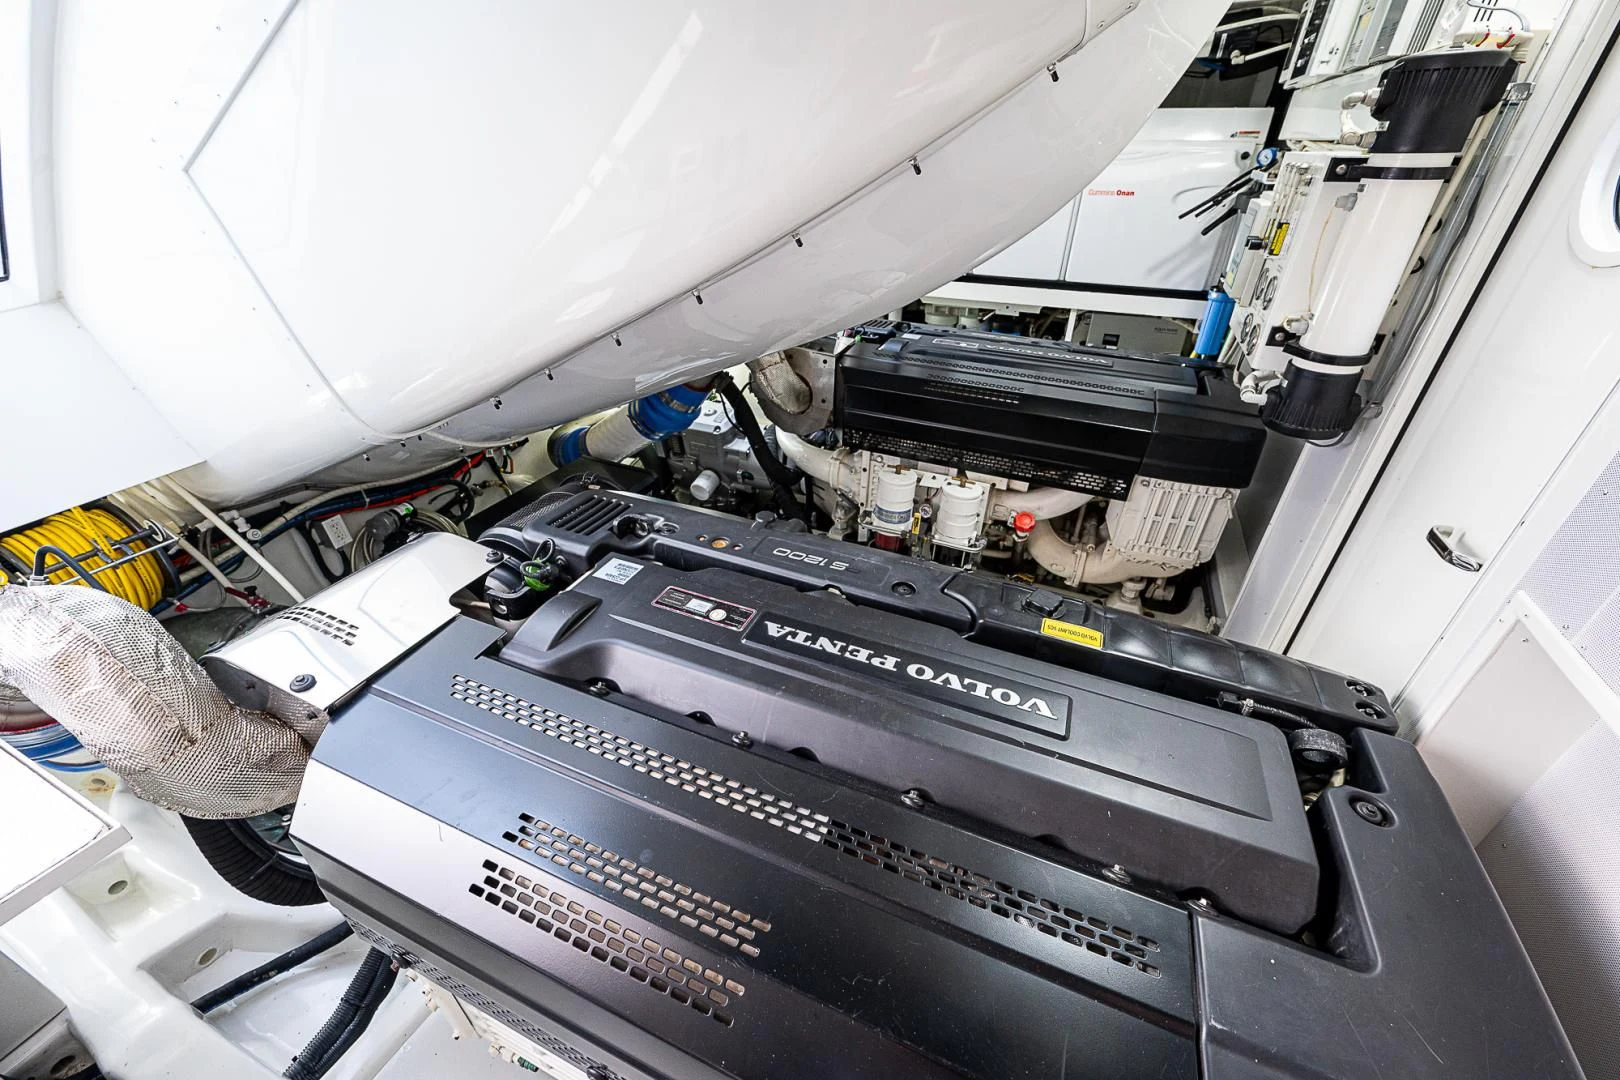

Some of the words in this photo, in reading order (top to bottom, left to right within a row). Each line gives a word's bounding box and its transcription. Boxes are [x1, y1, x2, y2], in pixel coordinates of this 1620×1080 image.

[772, 547, 828, 567] 1200
[829, 561, 850, 571] S
[1057, 627, 1080, 637] COOLANT
[1080, 633, 1098, 642] VOLVO
[766, 620, 901, 672] PENTA
[905, 662, 1059, 721] VOLVO
